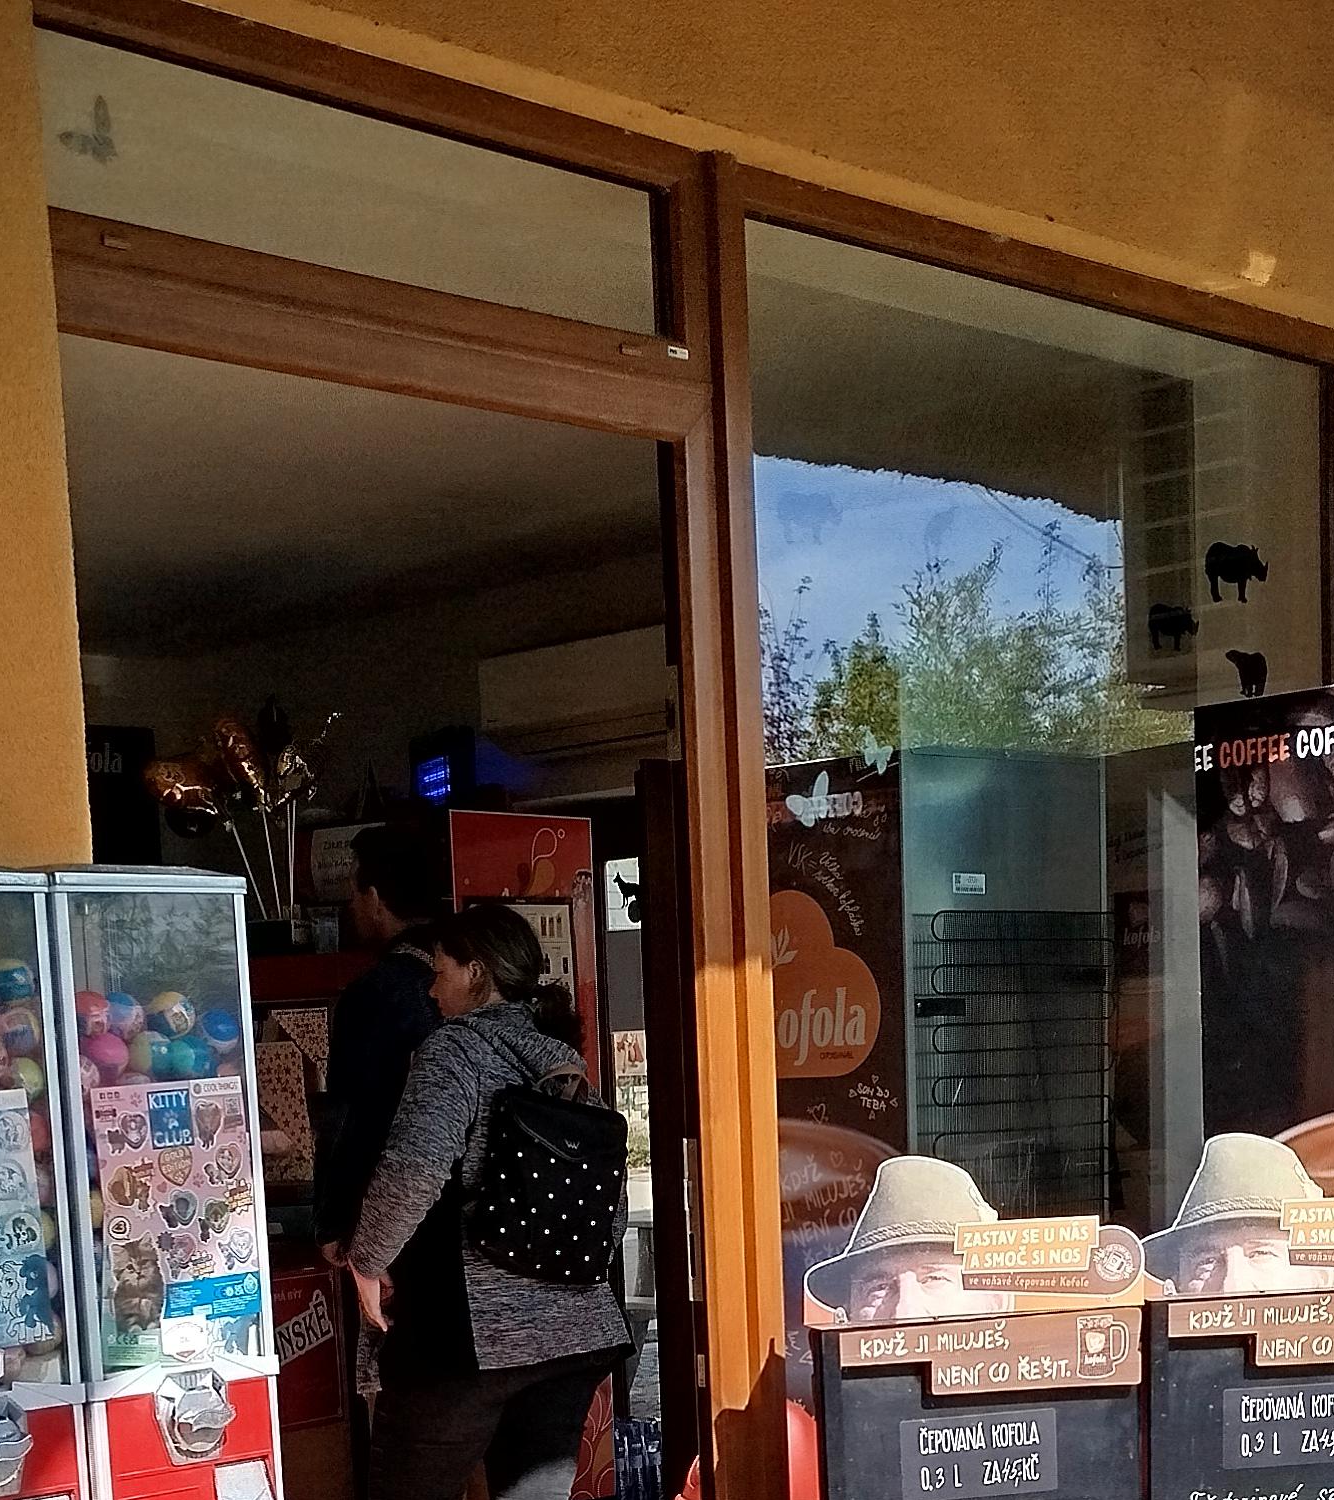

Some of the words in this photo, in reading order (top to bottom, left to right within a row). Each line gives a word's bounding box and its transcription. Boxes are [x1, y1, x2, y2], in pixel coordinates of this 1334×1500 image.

[1219, 733, 1291, 769] COFFEE
[776, 987, 867, 1066] ofola
[148, 1090, 188, 1109] KITTY
[154, 1128, 194, 1147] CLUB
[963, 1230, 1018, 1248] ZASTAV
[1022, 1228, 1040, 1244] SE
[1043, 1227, 1055, 1243] U
[1059, 1221, 1089, 1242] NÁS
[1296, 1229, 1307, 1244] A
[970, 1253, 980, 1268] A
[984, 1245, 1027, 1267] SMOČ
[1032, 1250, 1044, 1265] SI
[1049, 1248, 1081, 1264] NOS
[1189, 1304, 1235, 1330] KDYŽ
[1264, 1296, 1334, 1325] MILUJEŠ,
[860, 1331, 908, 1359] KDYŽ
[915, 1335, 930, 1354] JI
[938, 1321, 1010, 1352] MILUJEŠ,
[1262, 1336, 1309, 1359] NENÍ
[1312, 1336, 1333, 1355] CO
[938, 1363, 985, 1387] NENÍ
[988, 1361, 1010, 1381] CO
[1018, 1356, 1072, 1380] ŘEŠIT.
[1241, 1391, 1306, 1423] ČEPOVANÁ
[920, 1422, 986, 1455] ČEPOVANÁ
[991, 1421, 1040, 1448] KOFOLA
[1273, 1432, 1281, 1455] L
[954, 1463, 963, 1488] L
